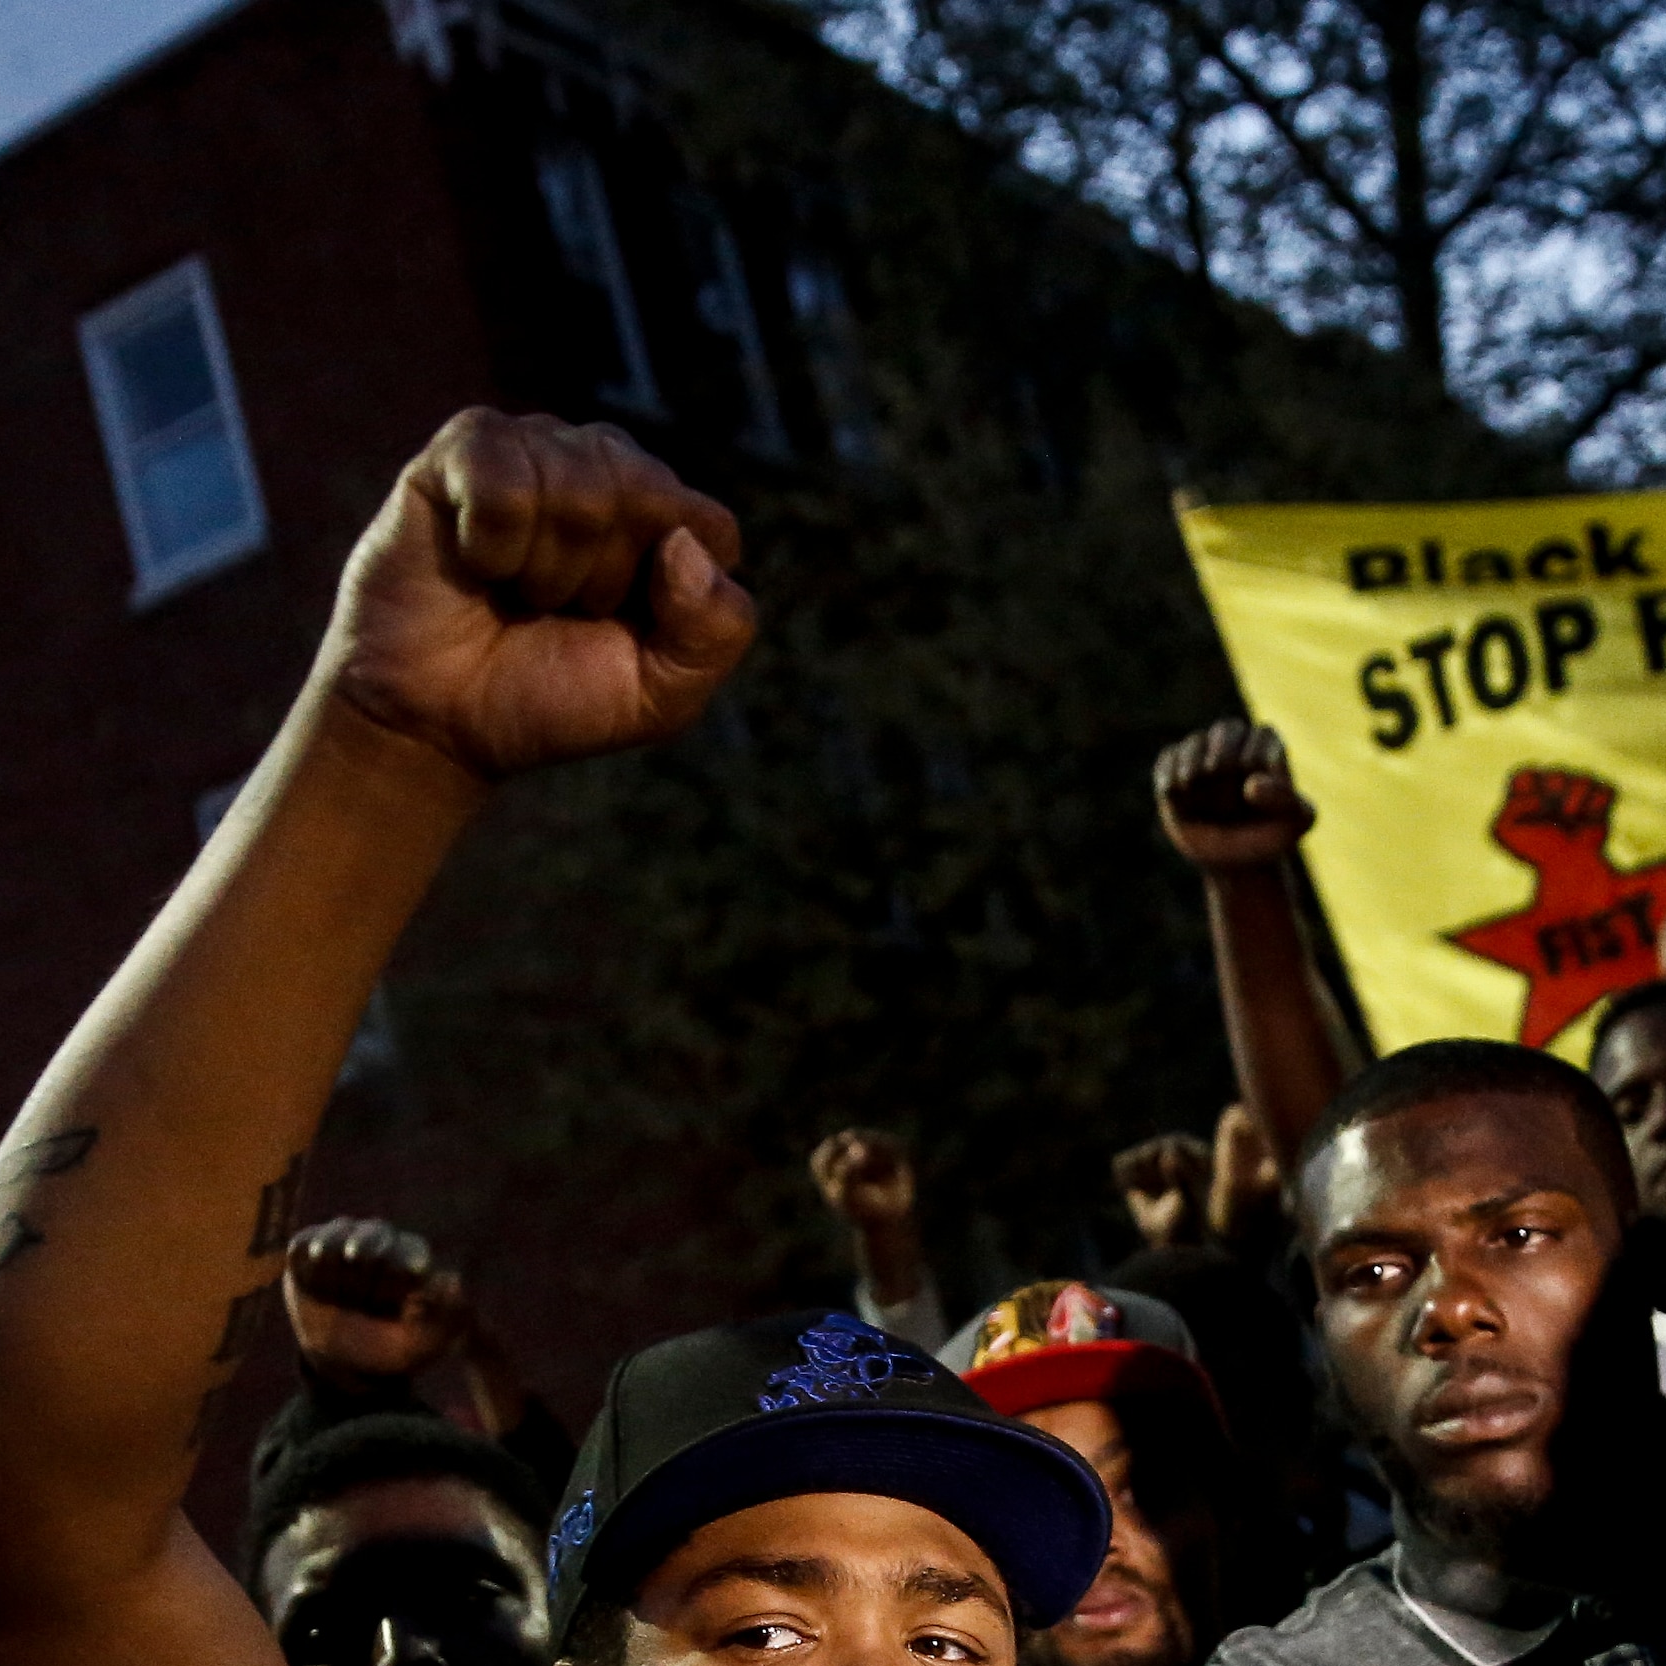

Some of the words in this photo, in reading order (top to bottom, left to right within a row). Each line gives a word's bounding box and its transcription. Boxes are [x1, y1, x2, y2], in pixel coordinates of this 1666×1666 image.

[1347, 519, 1655, 592] Black
[1359, 597, 1600, 752] STOP
[1537, 892, 1657, 978] FIST
